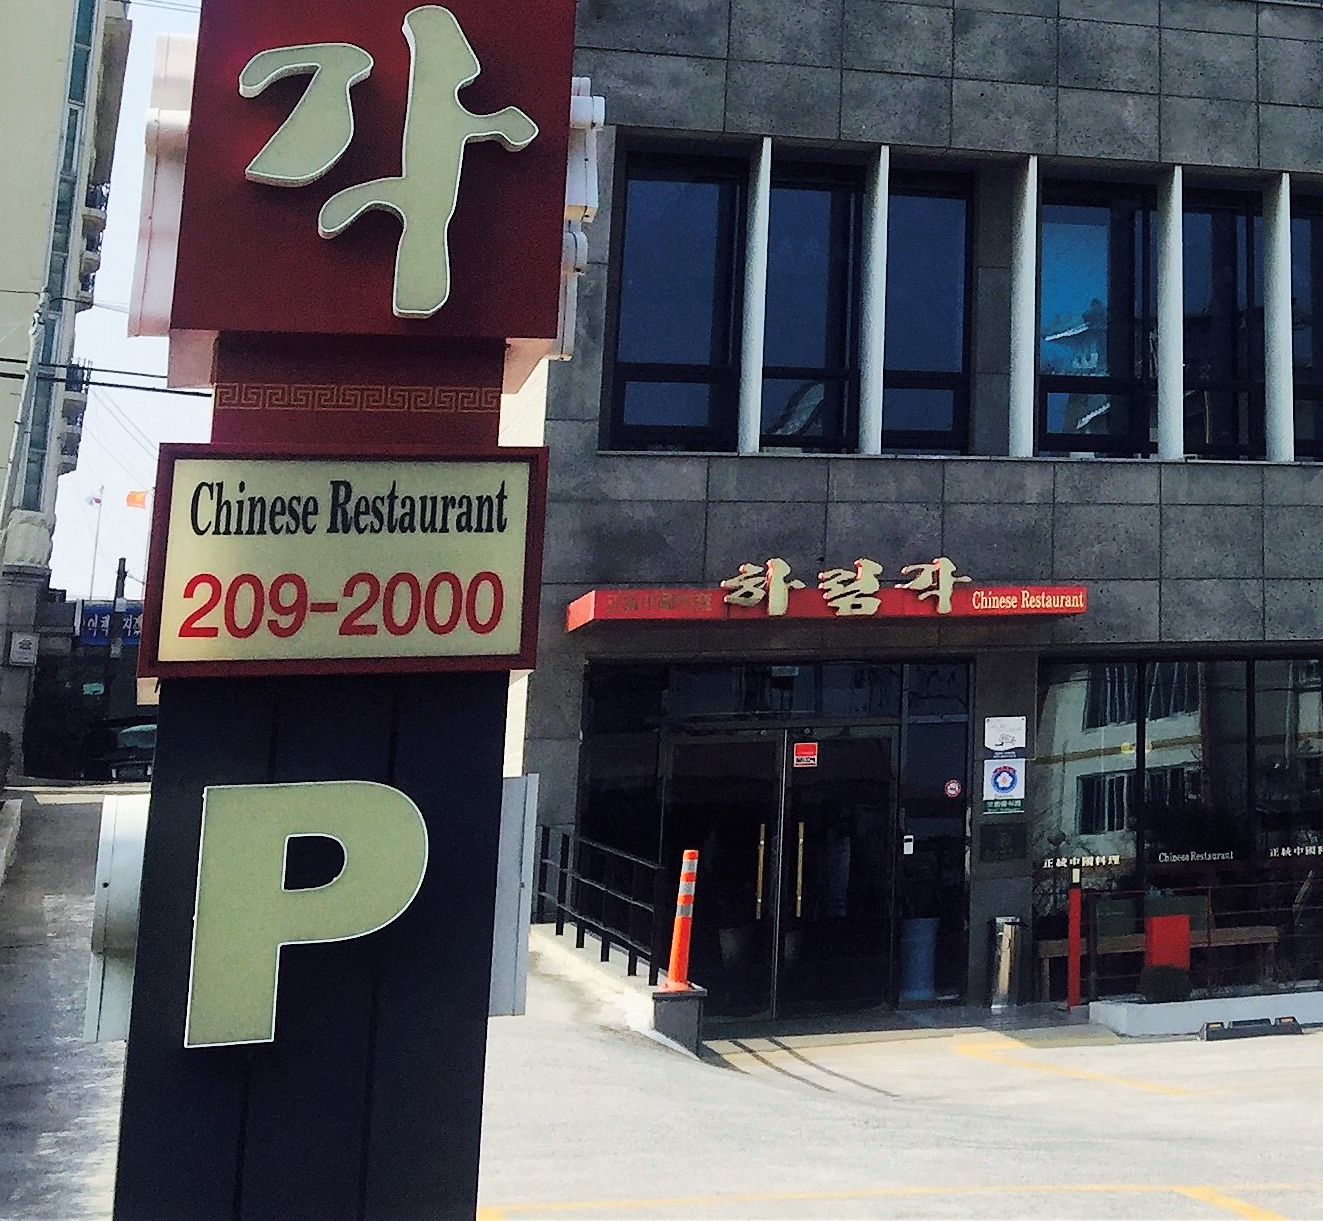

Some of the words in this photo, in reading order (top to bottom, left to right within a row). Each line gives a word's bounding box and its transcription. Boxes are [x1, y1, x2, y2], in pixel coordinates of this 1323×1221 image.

[190, 479, 319, 537] Chinese
[326, 479, 509, 535] Restaurant
[178, 570, 505, 640] 209-2000
[720, 556, 973, 617] 하림각
[971, 589, 1018, 609] Chinese
[1020, 589, 1085, 609] Restaurant
[184, 780, 429, 1049] P
